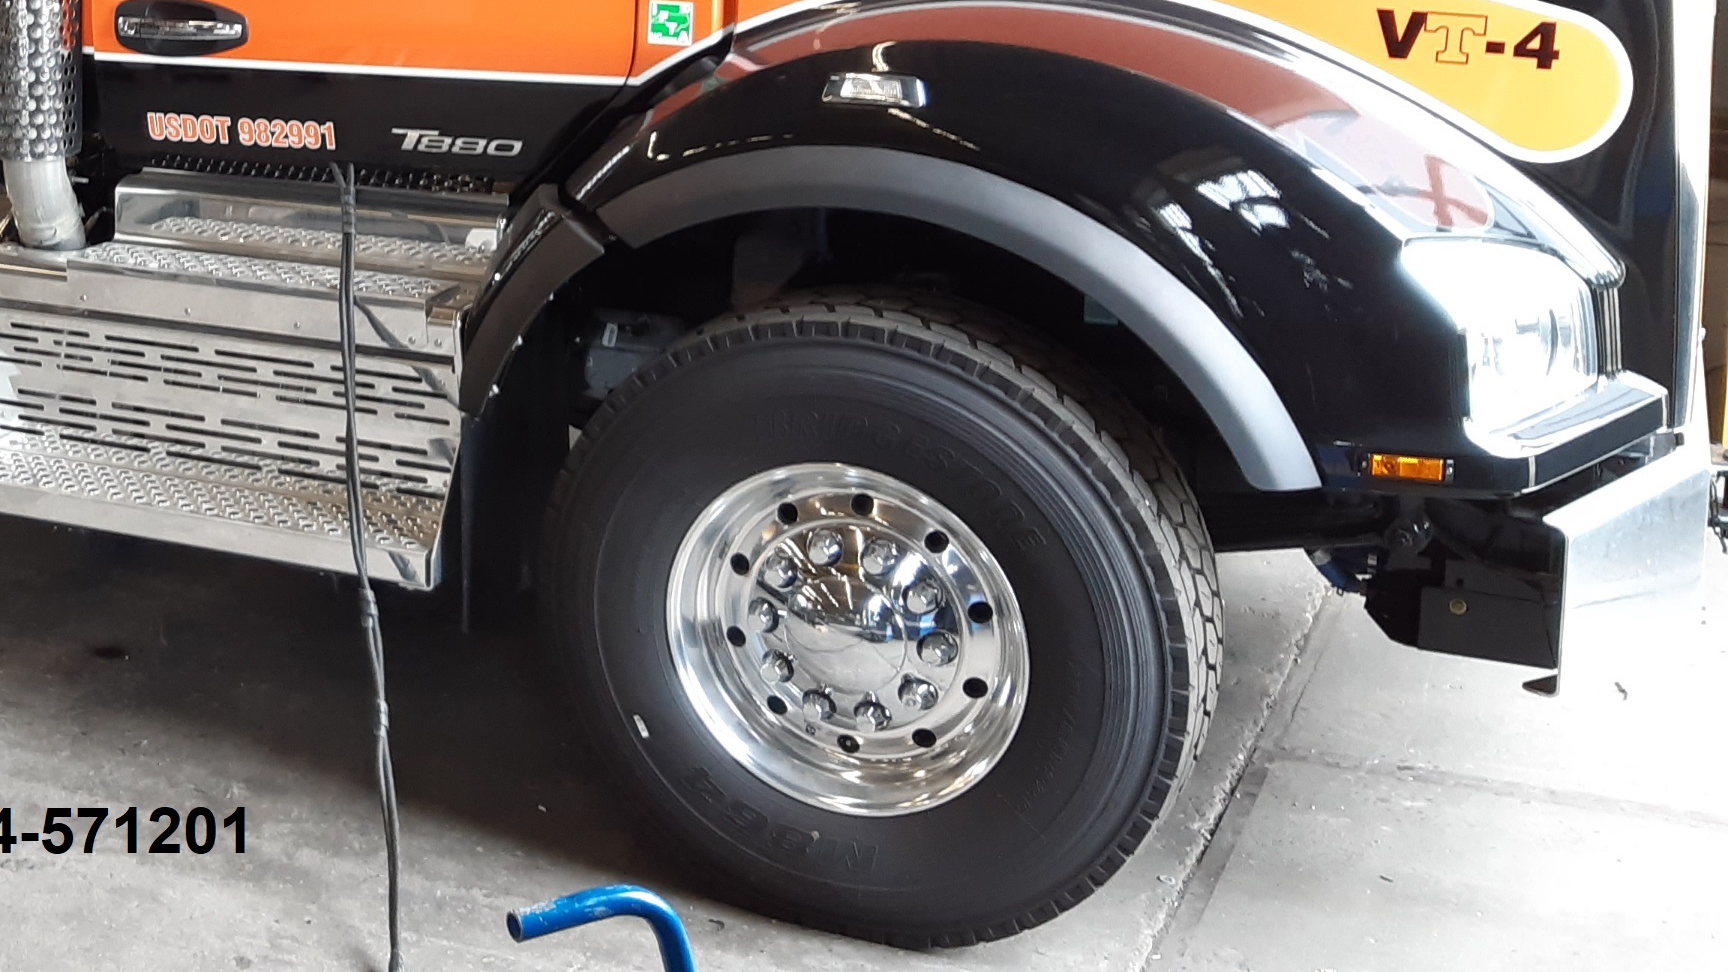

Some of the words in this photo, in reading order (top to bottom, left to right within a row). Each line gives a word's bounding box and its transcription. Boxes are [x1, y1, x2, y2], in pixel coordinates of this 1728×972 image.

[1377, 8, 1560, 69] VT-4
[147, 111, 232, 145] USDOT
[237, 117, 337, 151] 982991
[391, 127, 523, 157] T880
